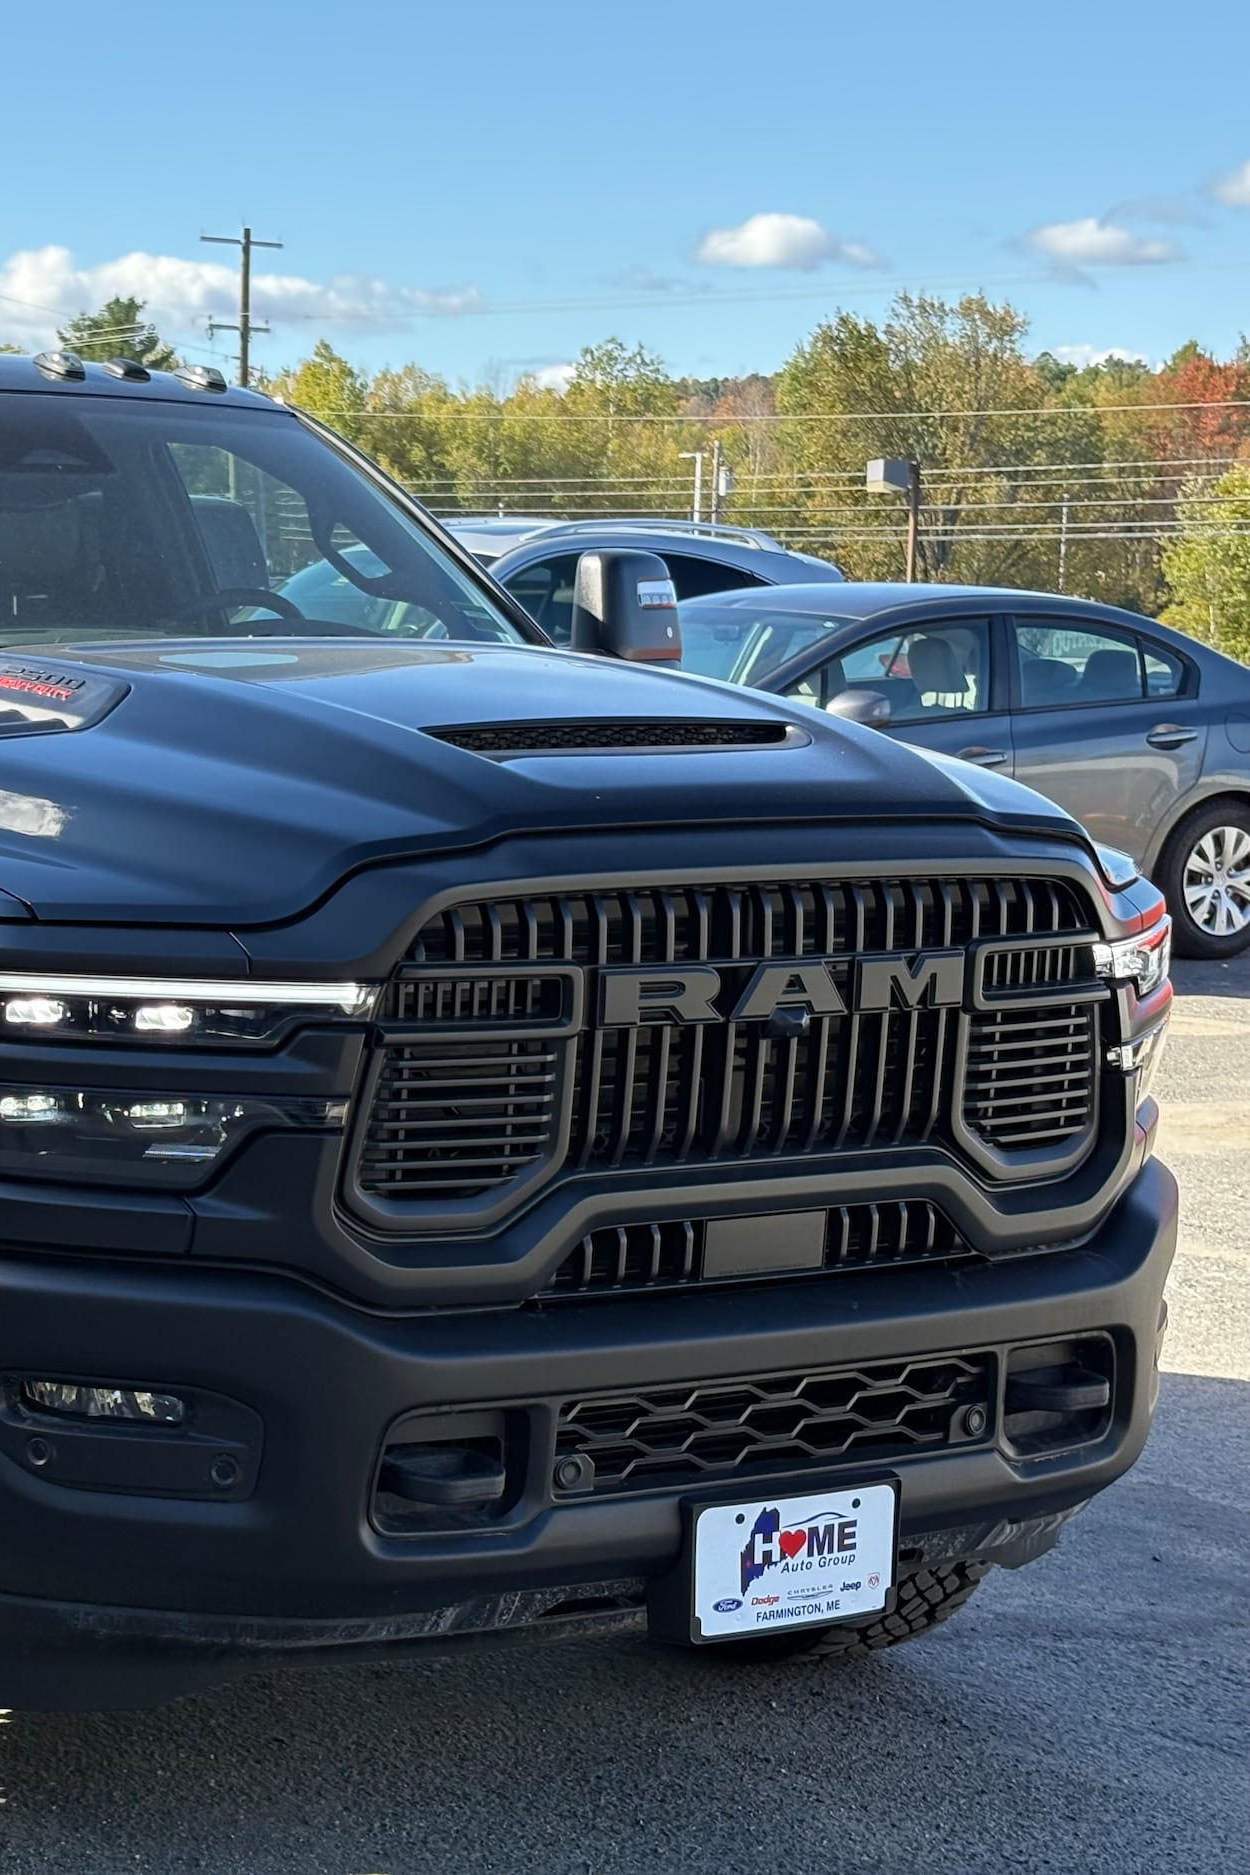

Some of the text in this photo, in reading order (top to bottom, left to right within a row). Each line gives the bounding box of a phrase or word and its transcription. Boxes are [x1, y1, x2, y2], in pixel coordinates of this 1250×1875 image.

[597, 949, 964, 1028] RAM
[781, 1553, 856, 1574] Auto Group
[787, 1585, 833, 1595] CHRYSLER
[840, 1580, 862, 1592] Jeep
[751, 1594, 780, 1607] Dodge
[756, 1600, 840, 1622] FARMINGTON, ME
